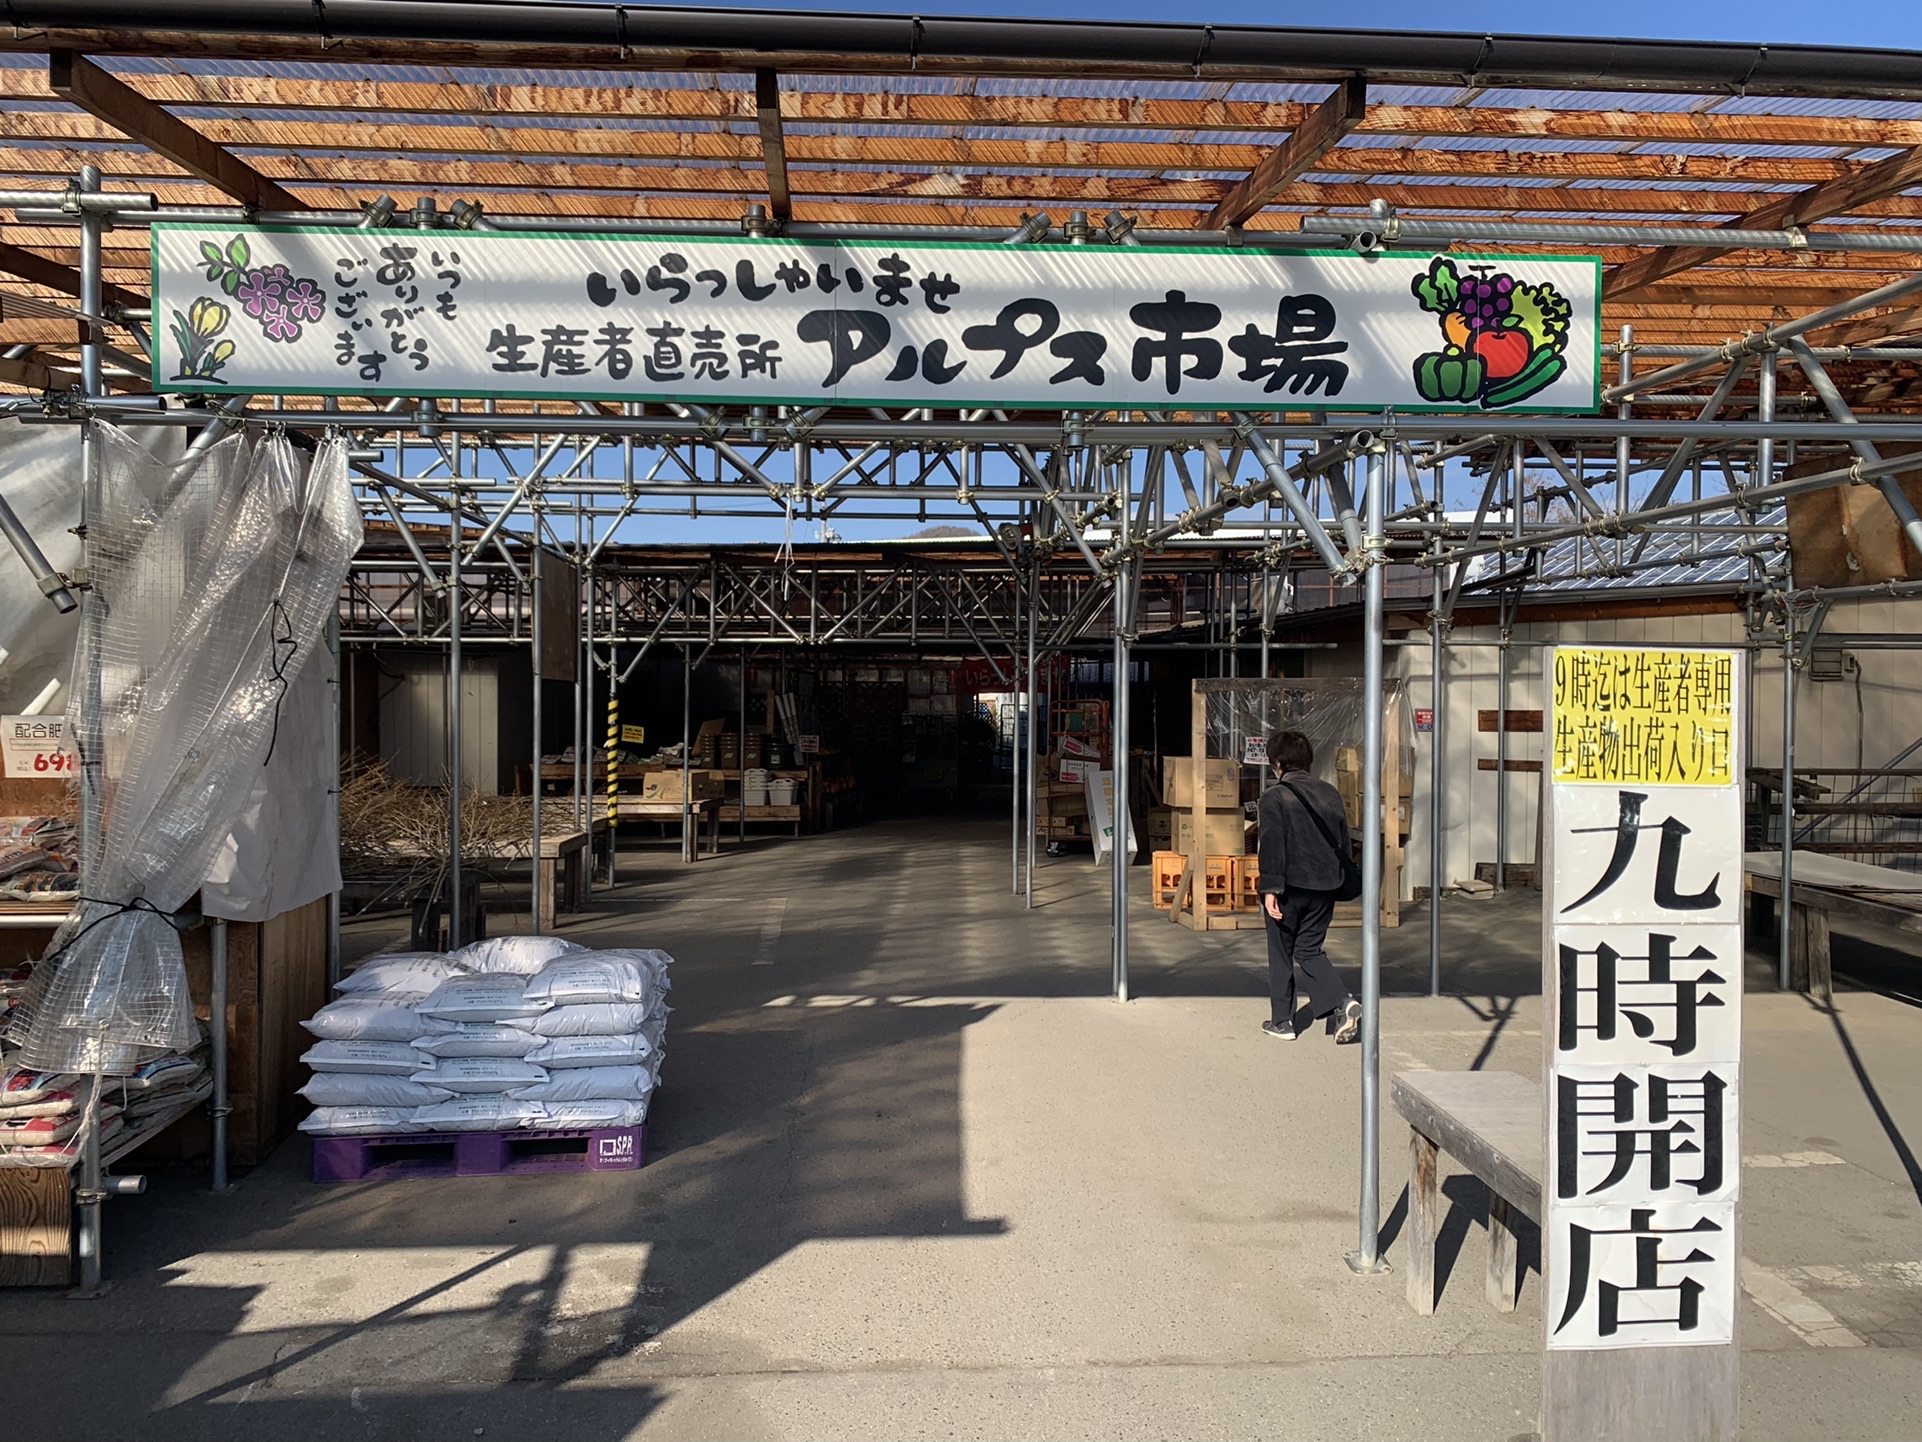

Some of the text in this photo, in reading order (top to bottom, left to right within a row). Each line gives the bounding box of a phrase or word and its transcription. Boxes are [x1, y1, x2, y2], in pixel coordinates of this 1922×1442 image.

[334, 258, 388, 382] ございます
[376, 242, 430, 371] ありがとう
[431, 251, 462, 321] いつも
[587, 252, 961, 313] いらっしゃいませ
[486, 288, 1349, 393] 生産者直売所 アルプス市場
[1555, 715, 1730, 782] 生産物出荷入り口
[1555, 790, 1727, 1338] 九時開店
